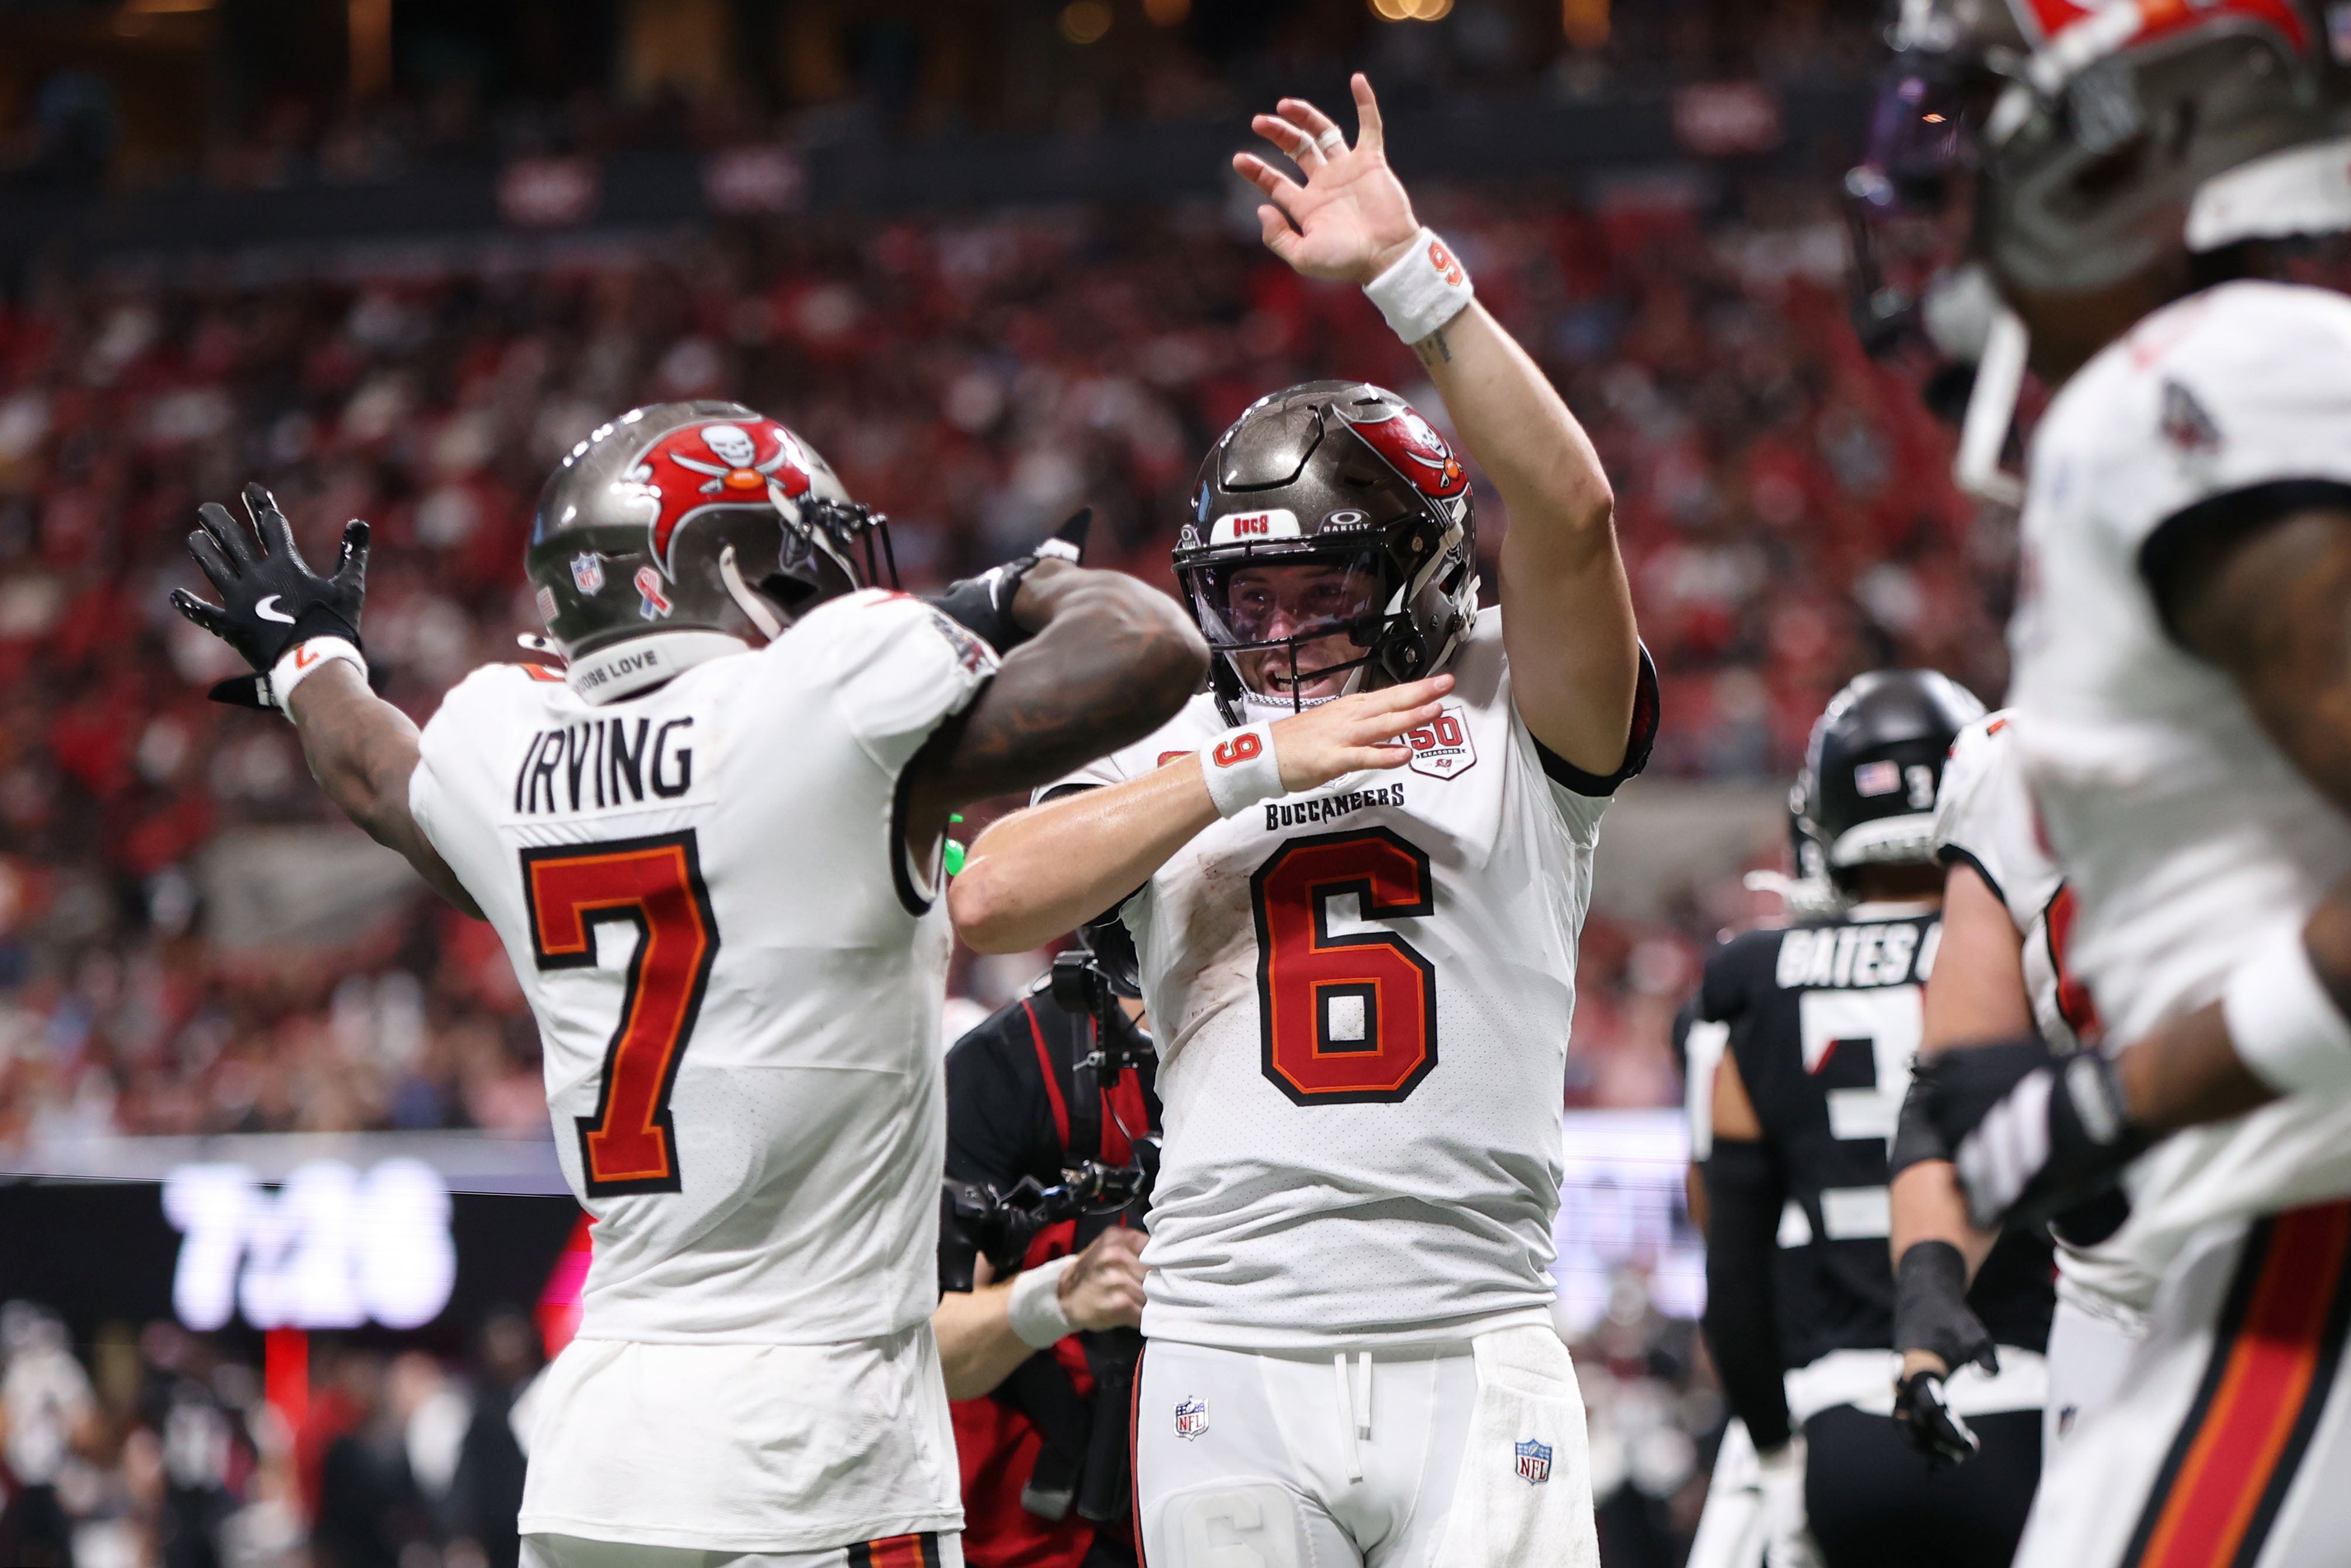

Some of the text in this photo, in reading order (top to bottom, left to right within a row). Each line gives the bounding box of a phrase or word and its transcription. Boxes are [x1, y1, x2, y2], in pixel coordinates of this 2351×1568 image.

[1324, 523, 1369, 533] OAKLEY
[608, 650, 658, 677] LOVE
[514, 716, 694, 814] IRVING
[1423, 749, 1458, 757] SEASONS
[1264, 783, 1405, 831] BUCCANEERS
[1249, 826, 1438, 1107] 6
[519, 828, 721, 1199] 7
[1179, 1415, 1202, 1432] NFL
[1520, 1457, 1547, 1481] NFL
